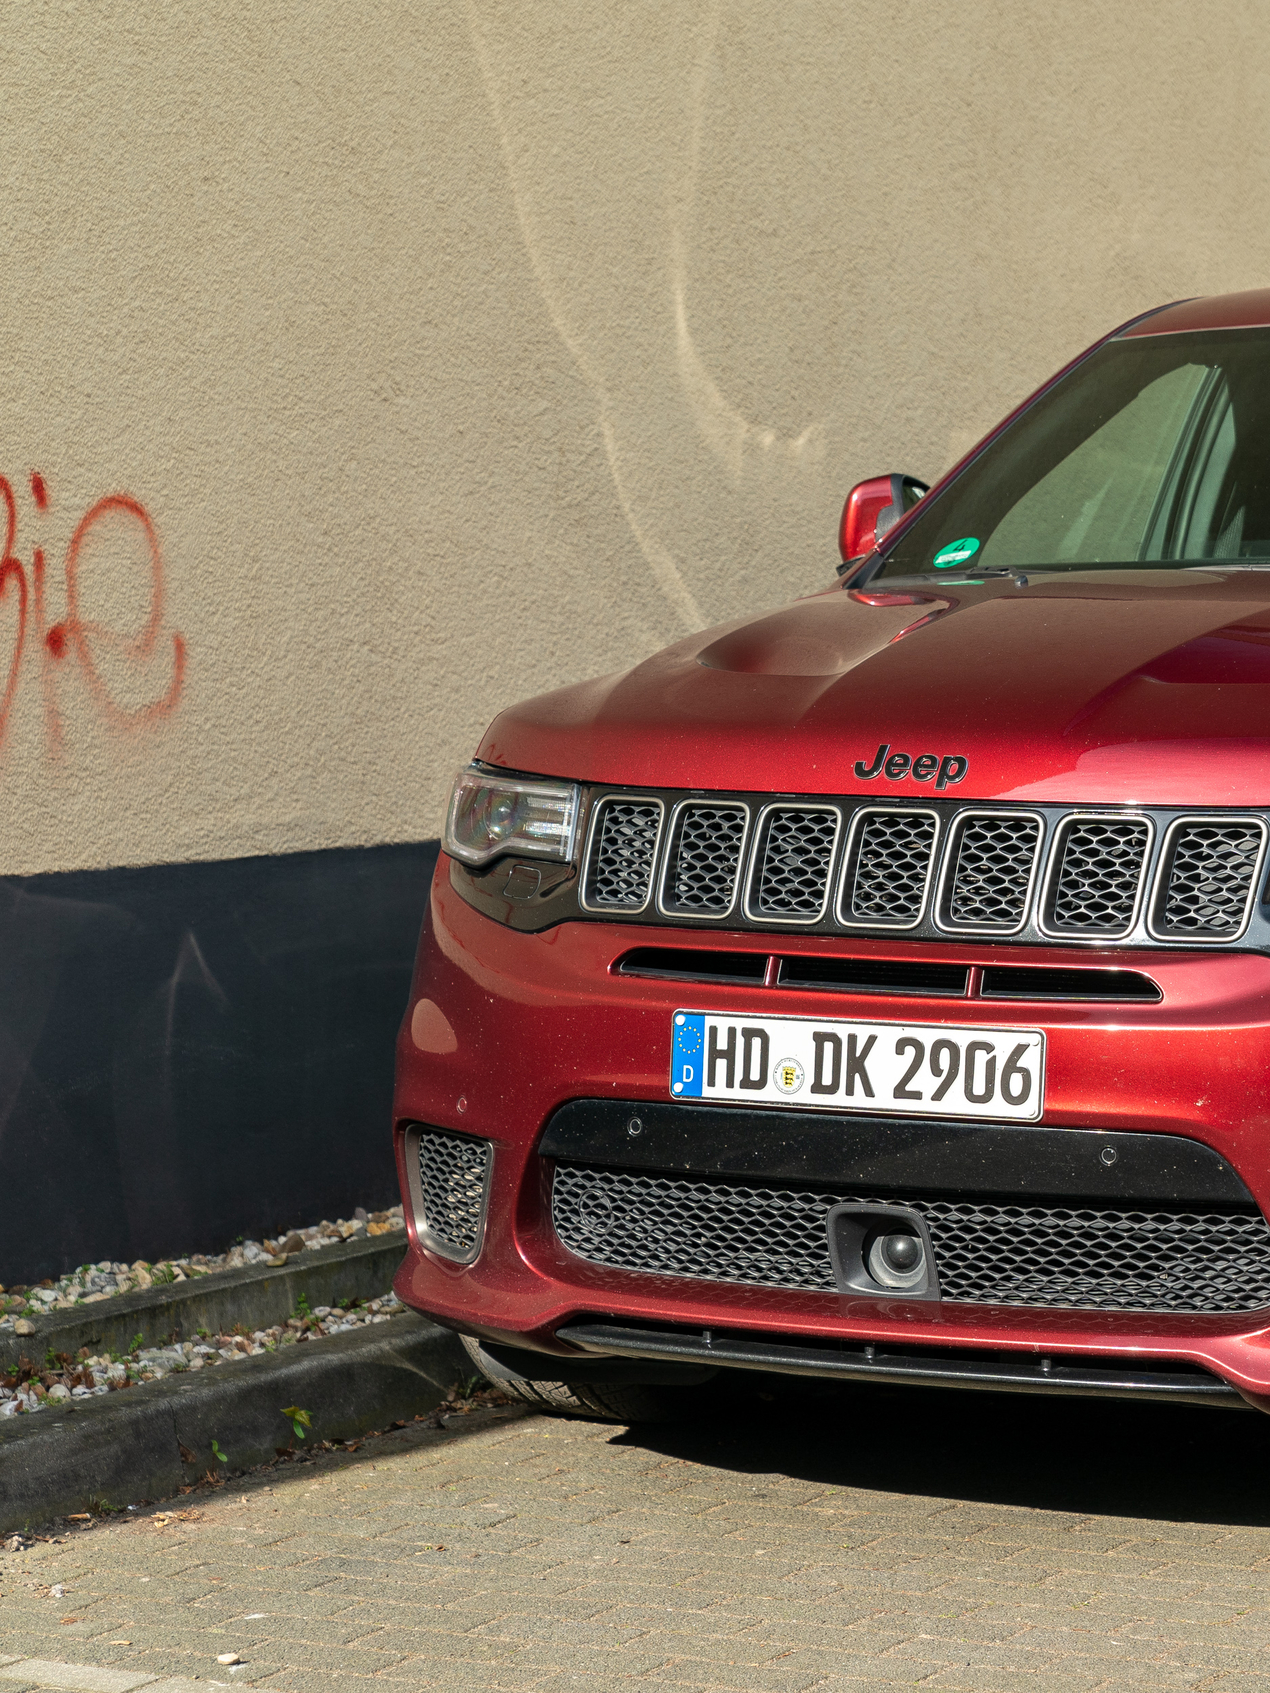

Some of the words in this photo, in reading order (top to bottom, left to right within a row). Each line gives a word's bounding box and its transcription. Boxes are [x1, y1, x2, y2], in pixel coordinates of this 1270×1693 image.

[854, 744, 969, 790] Jeep
[682, 1065, 694, 1083] D
[707, 1025, 770, 1090] HD
[810, 1031, 878, 1098] DK
[893, 1037, 1031, 1106] 2906
